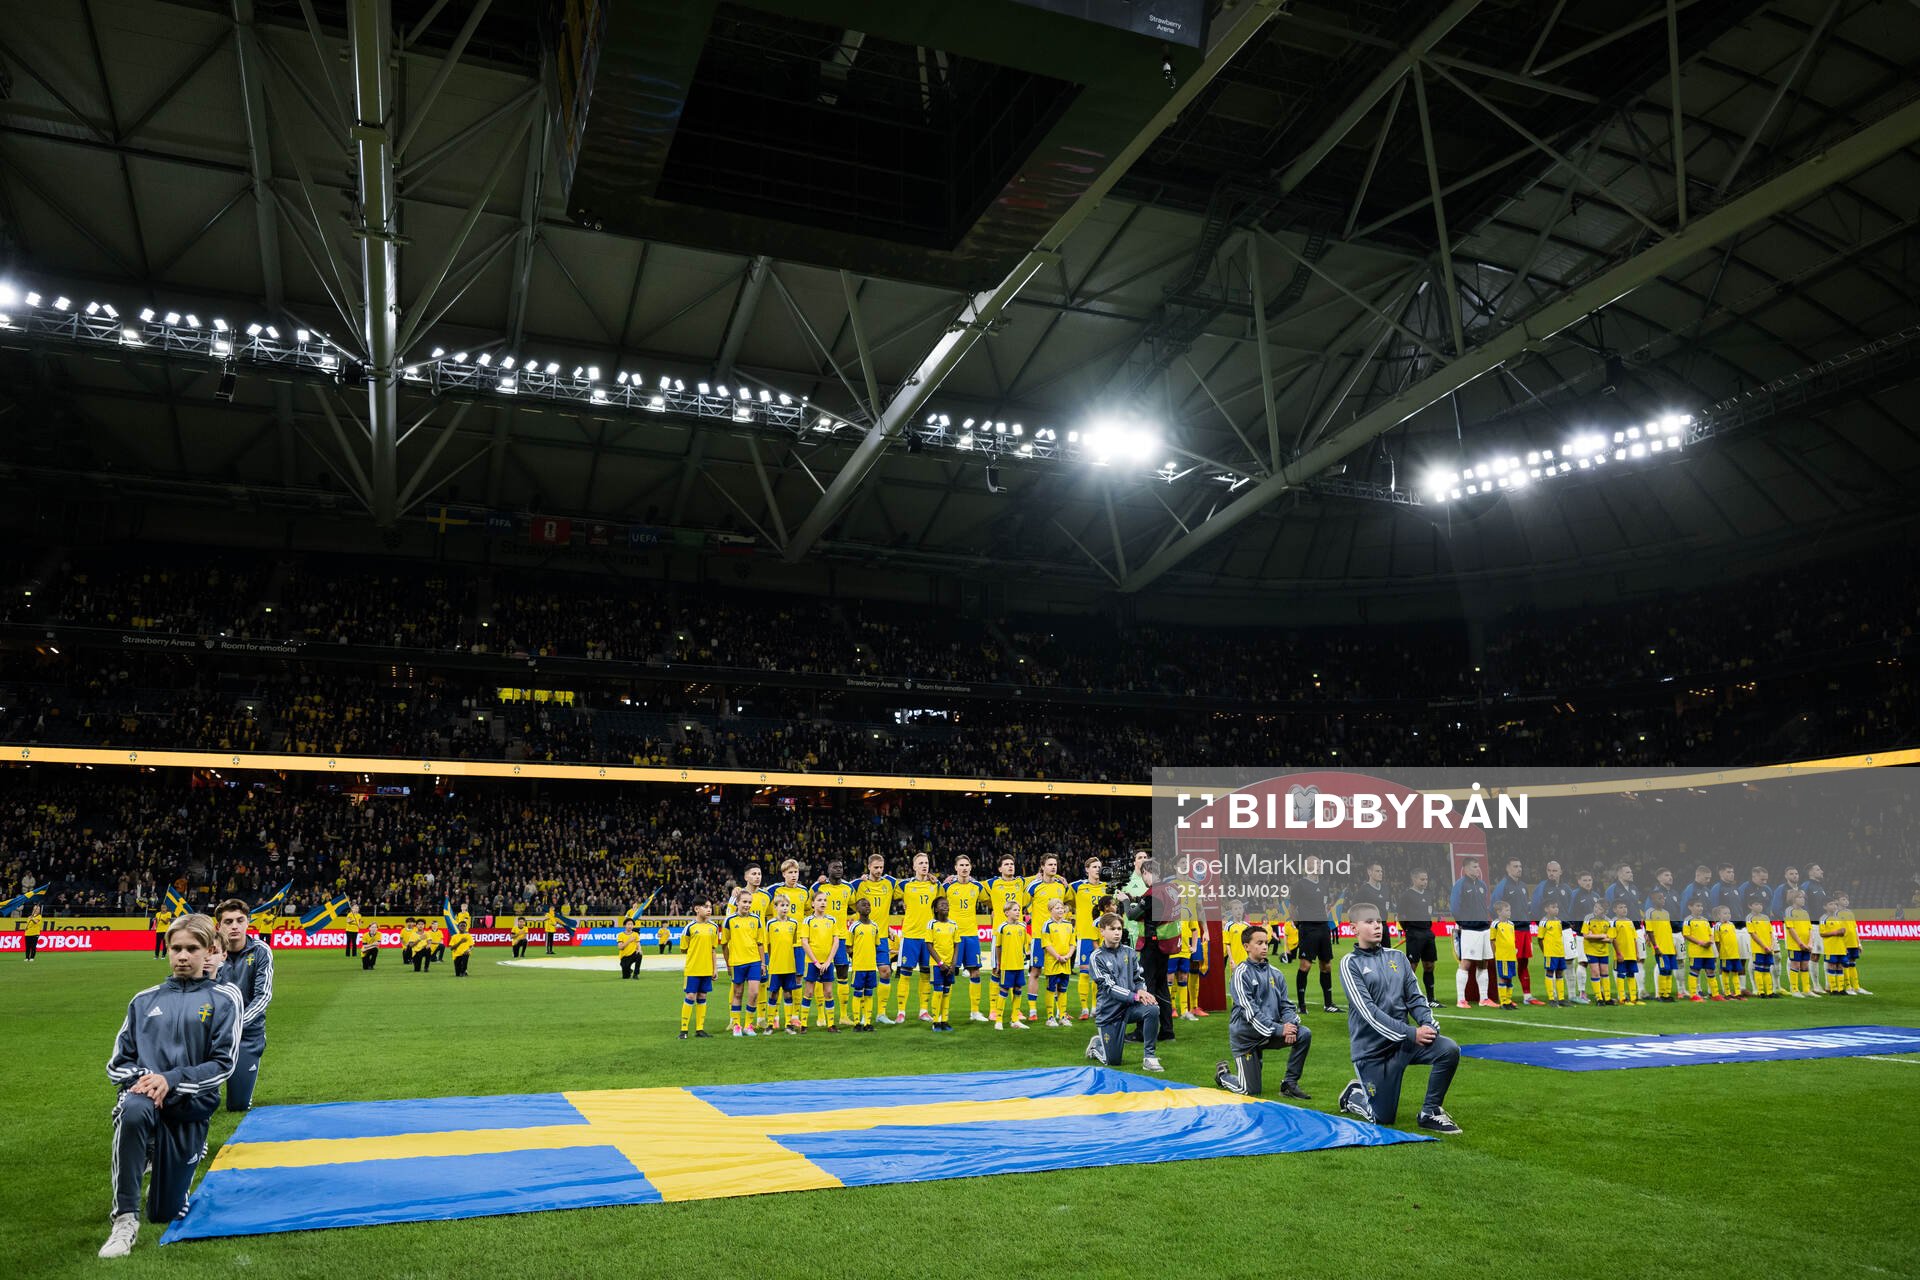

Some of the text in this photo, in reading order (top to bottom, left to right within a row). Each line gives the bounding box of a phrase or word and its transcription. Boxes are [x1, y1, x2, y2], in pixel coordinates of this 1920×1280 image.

[1149, 14, 1182, 30] Strawberry
[1156, 24, 1175, 34] Arena
[488, 518, 512, 528] FIFA
[632, 533, 658, 544] UEFA
[122, 635, 195, 648] Strawberry Arena
[221, 641, 297, 653] Room for emotions
[832, 900, 842, 910] 13
[874, 897, 881, 907] 11
[960, 899, 969, 909] 15
[791, 904, 797, 914] 8
[15, 921, 111, 931] Flksam
[36, 935, 92, 949] OTBOLL
[273, 930, 302, 946] FÖR
[305, 933, 348, 946] SVENS
[472, 933, 570, 943] EUROPEA UALIERS
[577, 933, 619, 941] FIFA WORL
